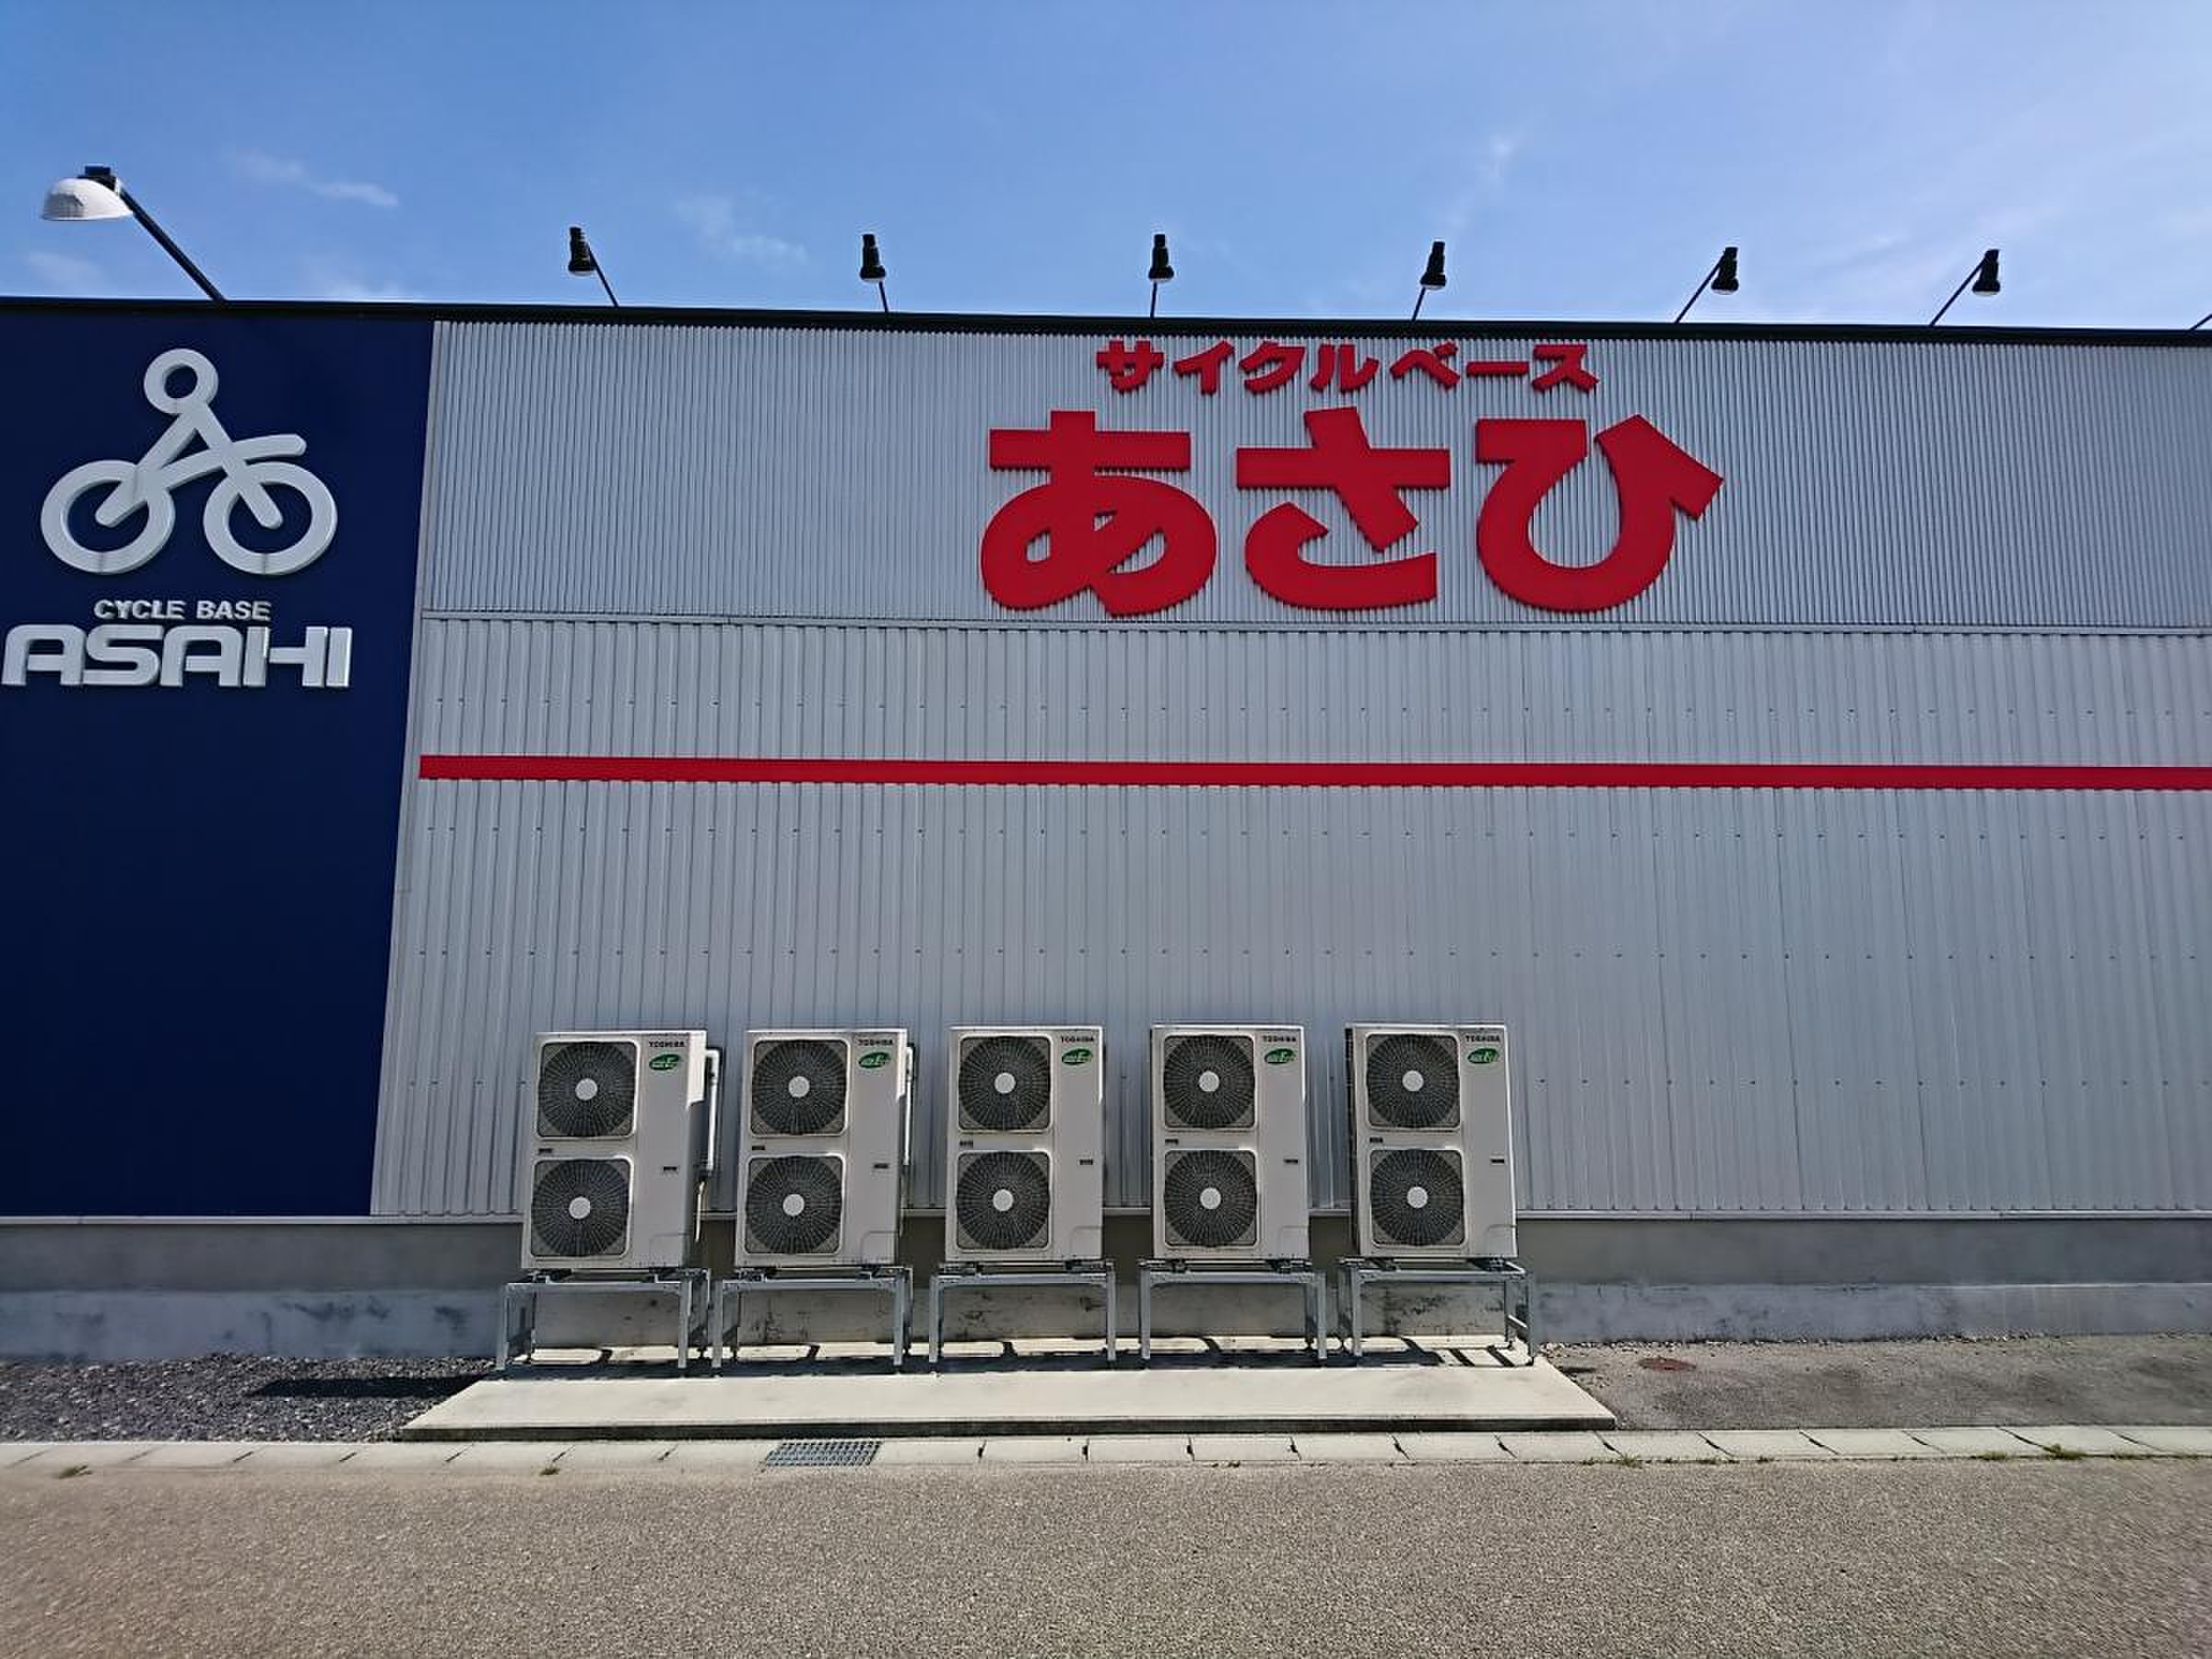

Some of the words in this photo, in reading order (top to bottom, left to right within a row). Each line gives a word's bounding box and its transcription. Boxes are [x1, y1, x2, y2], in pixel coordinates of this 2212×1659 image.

[1096, 338, 1600, 395] サイクルベース
[980, 406, 1724, 618] あさひ
[93, 599, 186, 620] CYCLE
[195, 599, 272, 621] BASE
[2, 623, 353, 688] ASAHI
